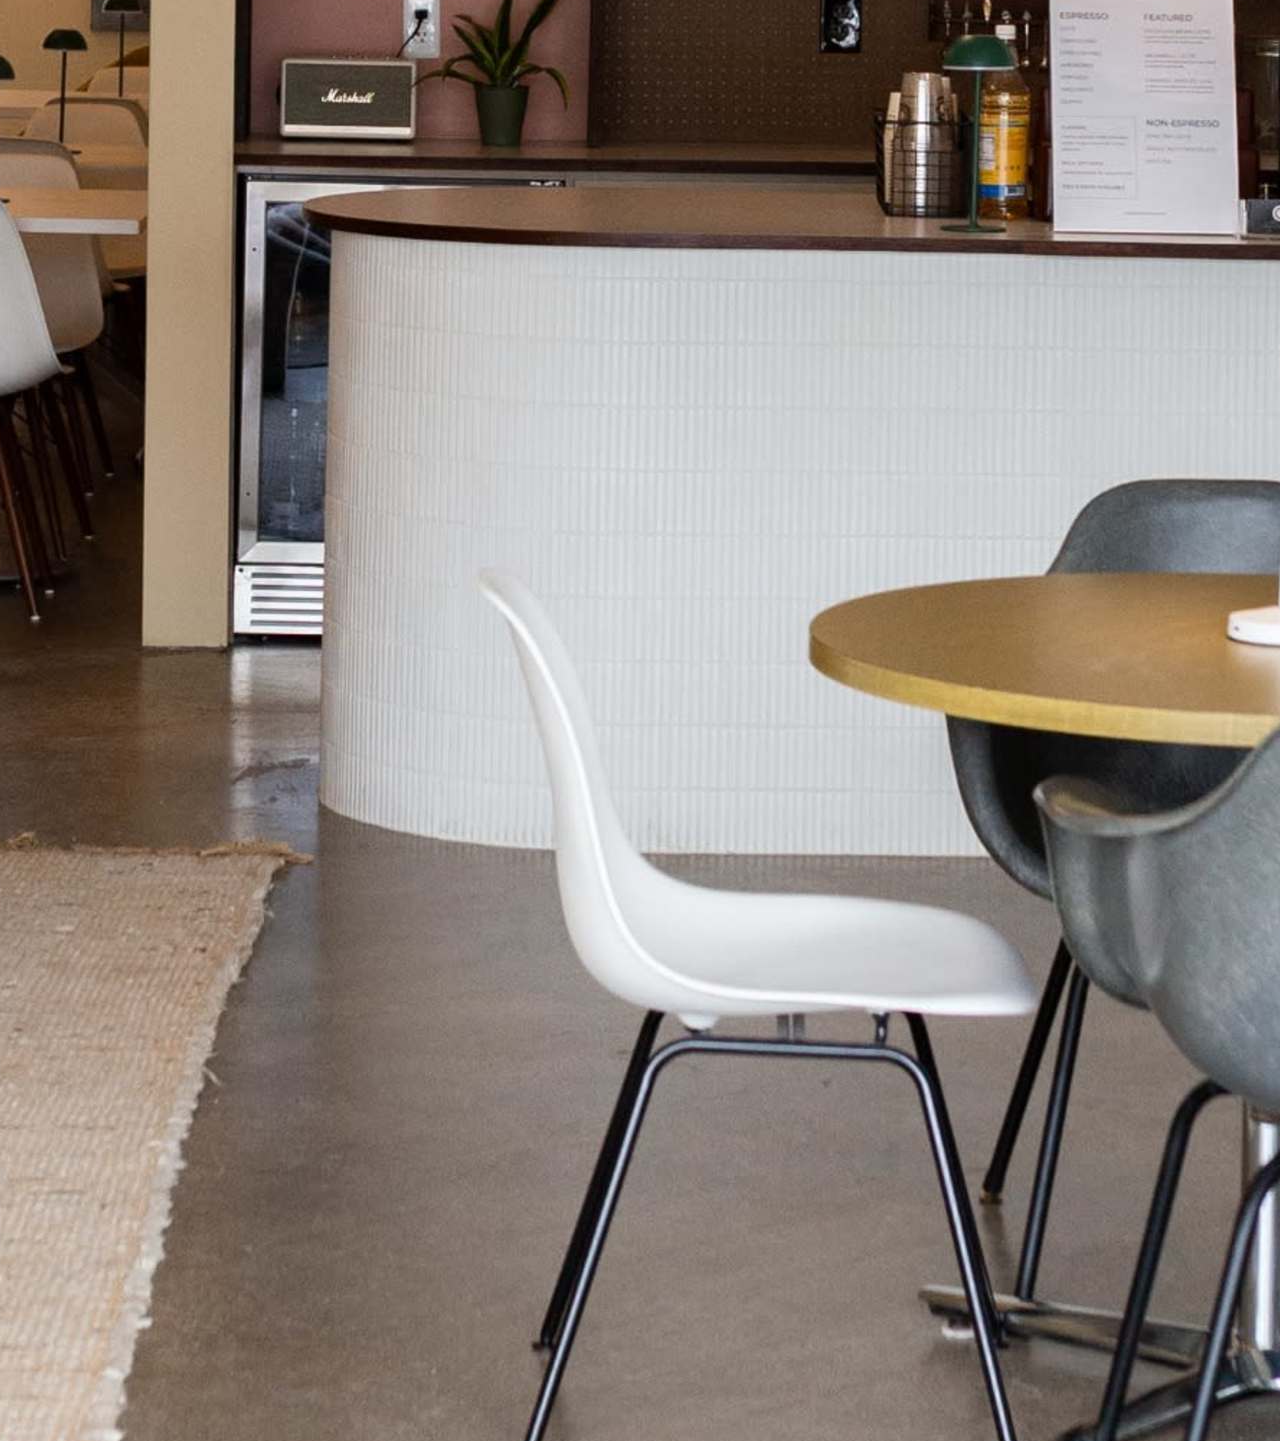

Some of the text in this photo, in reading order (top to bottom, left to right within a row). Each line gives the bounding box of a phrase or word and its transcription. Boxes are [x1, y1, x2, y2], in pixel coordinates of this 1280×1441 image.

[1059, 11, 1109, 20] ESPRESSO
[1143, 13, 1193, 22] FEATURED
[321, 87, 376, 104] Marshall
